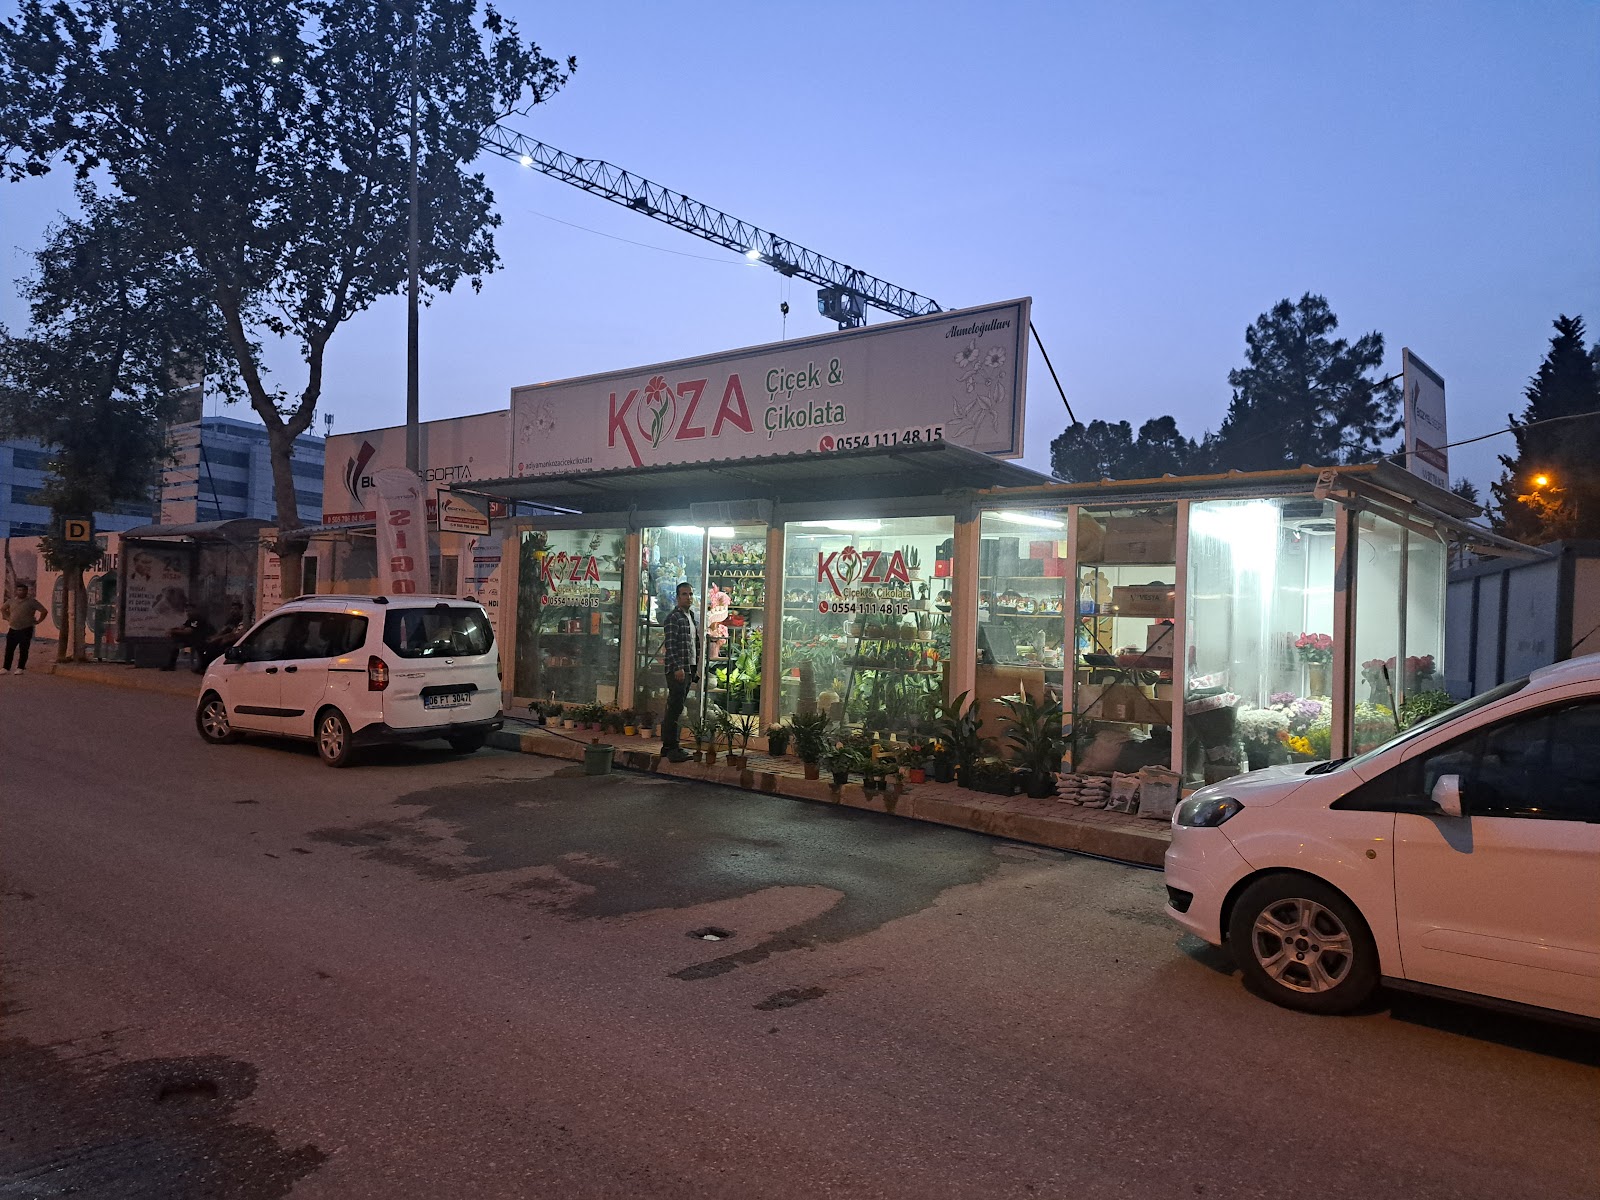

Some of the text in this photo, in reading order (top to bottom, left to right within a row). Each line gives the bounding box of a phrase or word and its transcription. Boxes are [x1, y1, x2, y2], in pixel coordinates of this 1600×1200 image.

[766, 358, 842, 401] Çiçek &
[608, 373, 754, 467] KOZA
[764, 401, 845, 438] Çikolata
[836, 427, 943, 450] 0554 111 48 15
[70, 523, 85, 538] D
[540, 551, 600, 592] KOZA
[817, 545, 910, 598] KOZA
[549, 597, 566, 606] 0554
[580, 598, 589, 607] 48
[590, 598, 599, 607] 15
[843, 587, 911, 600] Çiçek & Çikolata
[831, 603, 908, 615] 0554 111 48 15
[440, 695, 449, 704] FT
[452, 693, 469, 703] 3047
